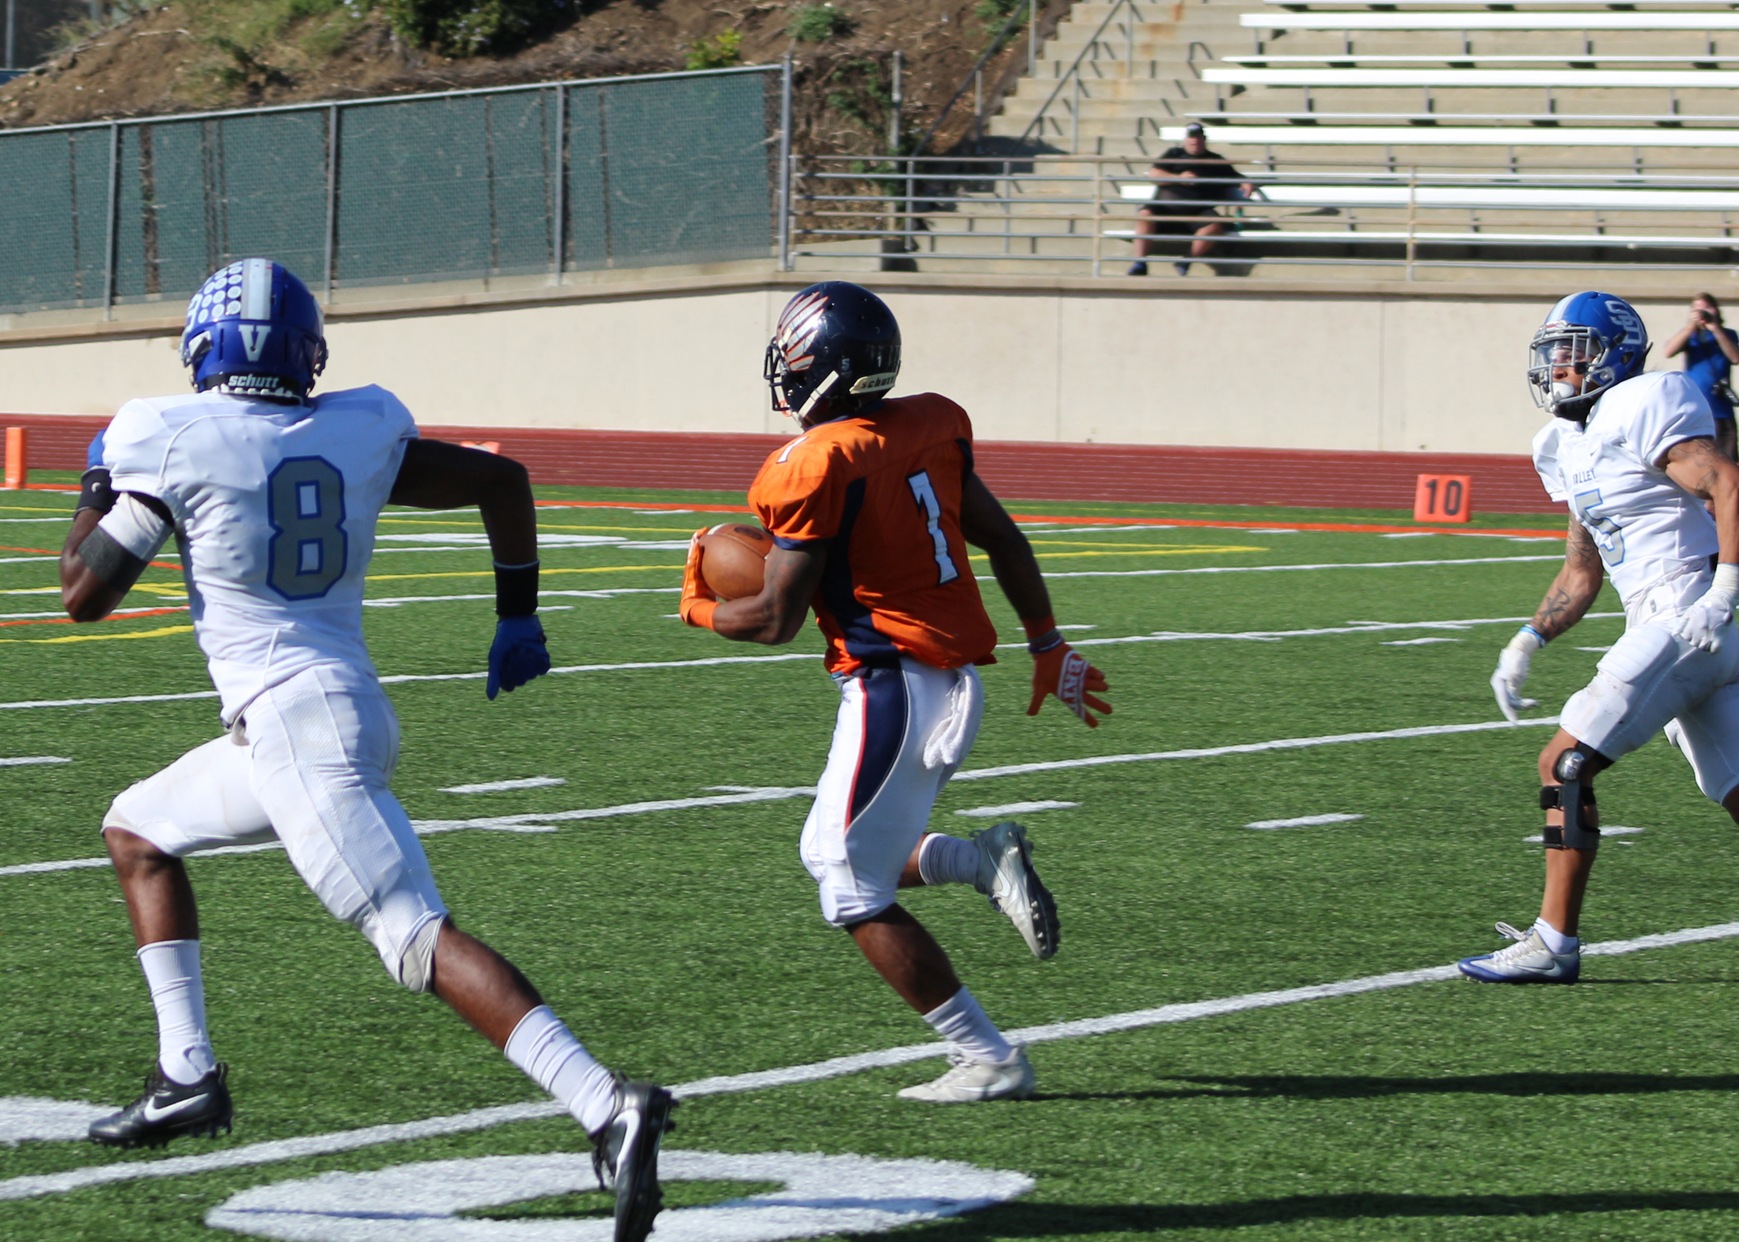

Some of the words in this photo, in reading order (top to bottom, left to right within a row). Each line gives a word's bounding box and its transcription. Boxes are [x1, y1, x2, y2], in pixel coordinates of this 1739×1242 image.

[238, 324, 271, 361] V
[228, 374, 279, 388] schutt
[1425, 479, 1463, 516] 10
[266, 455, 348, 601] 8
[906, 468, 959, 586] 1
[1574, 488, 1625, 567] 5
